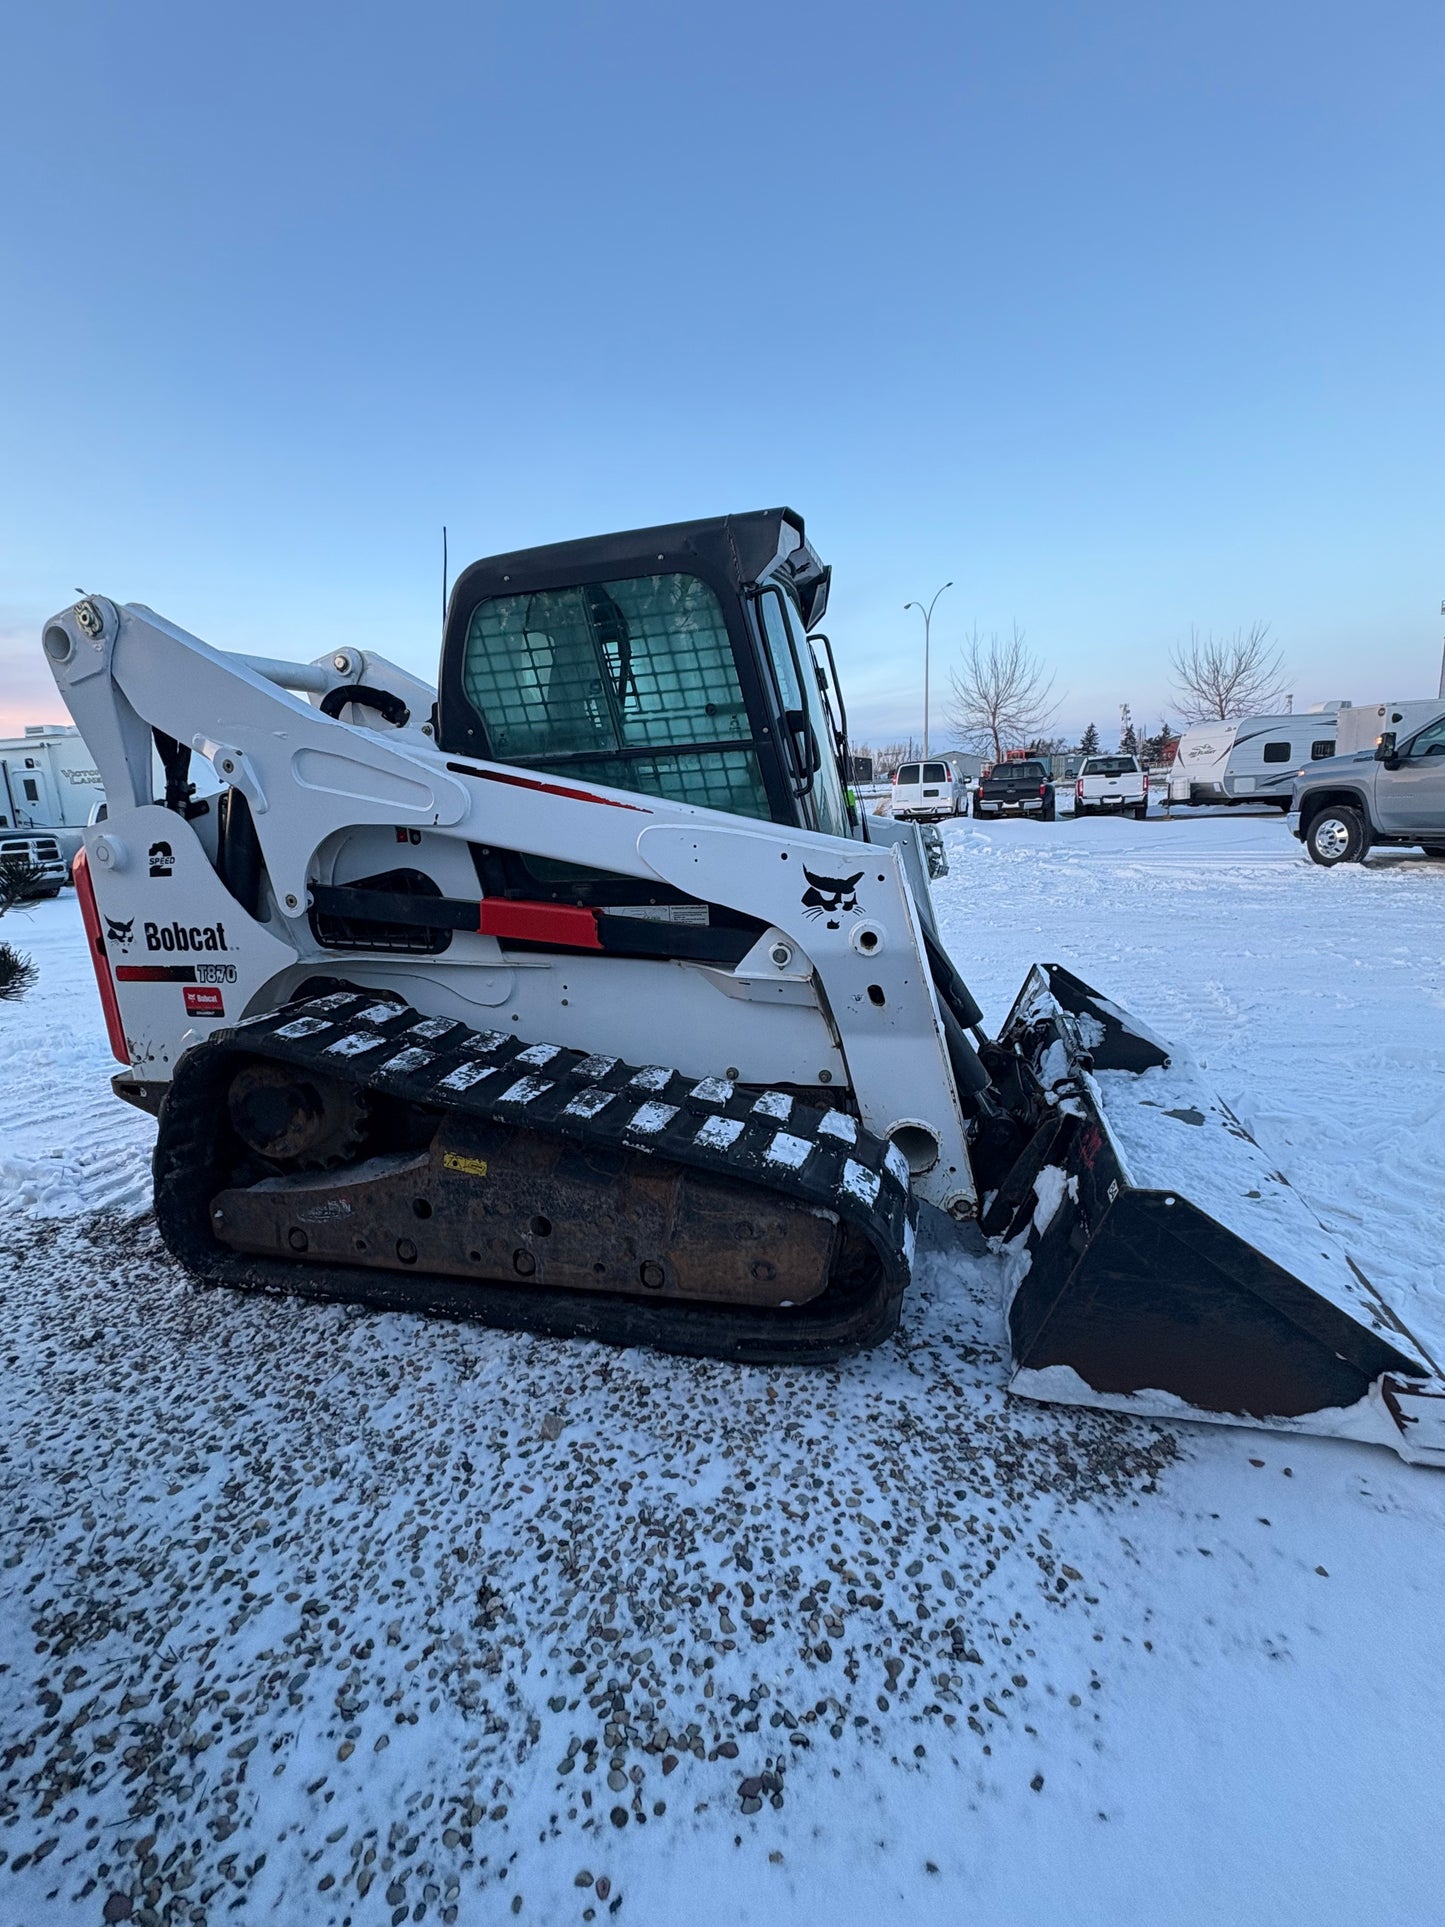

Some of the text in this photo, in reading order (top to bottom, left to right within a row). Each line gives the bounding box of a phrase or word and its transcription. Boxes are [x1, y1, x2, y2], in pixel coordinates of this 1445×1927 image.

[149, 841, 172, 877] 2
[149, 856, 176, 866] SPEED
[144, 921, 228, 951] Bobcat
[196, 964, 238, 983] T870
